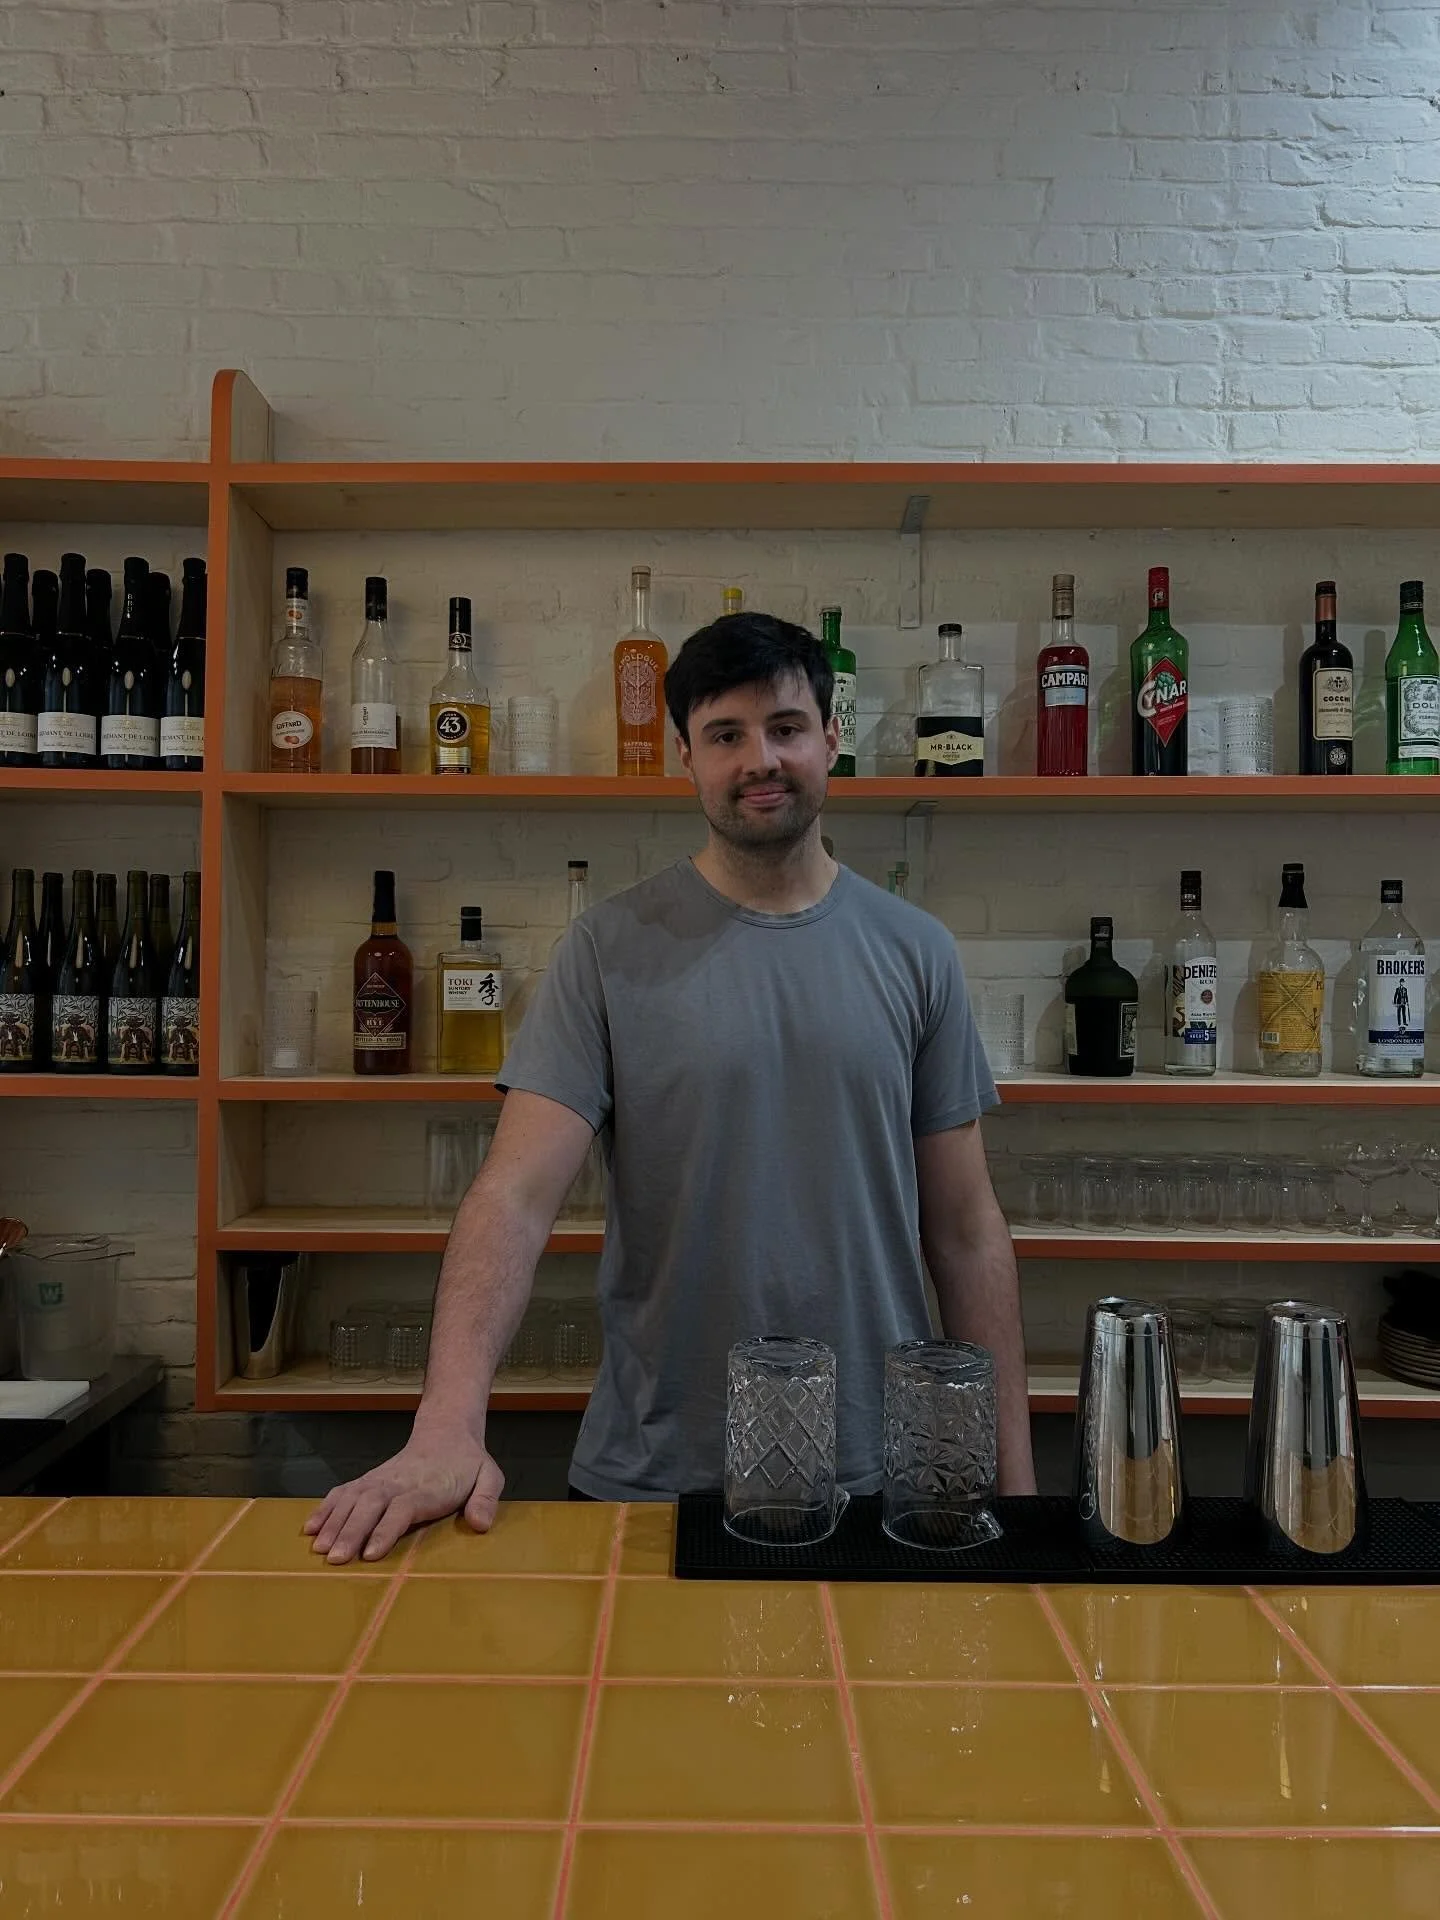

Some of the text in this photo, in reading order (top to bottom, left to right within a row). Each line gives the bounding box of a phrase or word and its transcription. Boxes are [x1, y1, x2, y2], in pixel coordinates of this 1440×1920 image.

[1137, 678, 1187, 718] CYNAR
[276, 720, 302, 730] GIFFARD
[440, 716, 461, 733] 43
[1376, 959, 1425, 975] BROKER'S
[448, 978, 473, 986] TOKI
[478, 972, 500, 1006] 季
[1204, 1029, 1210, 1041] 5
